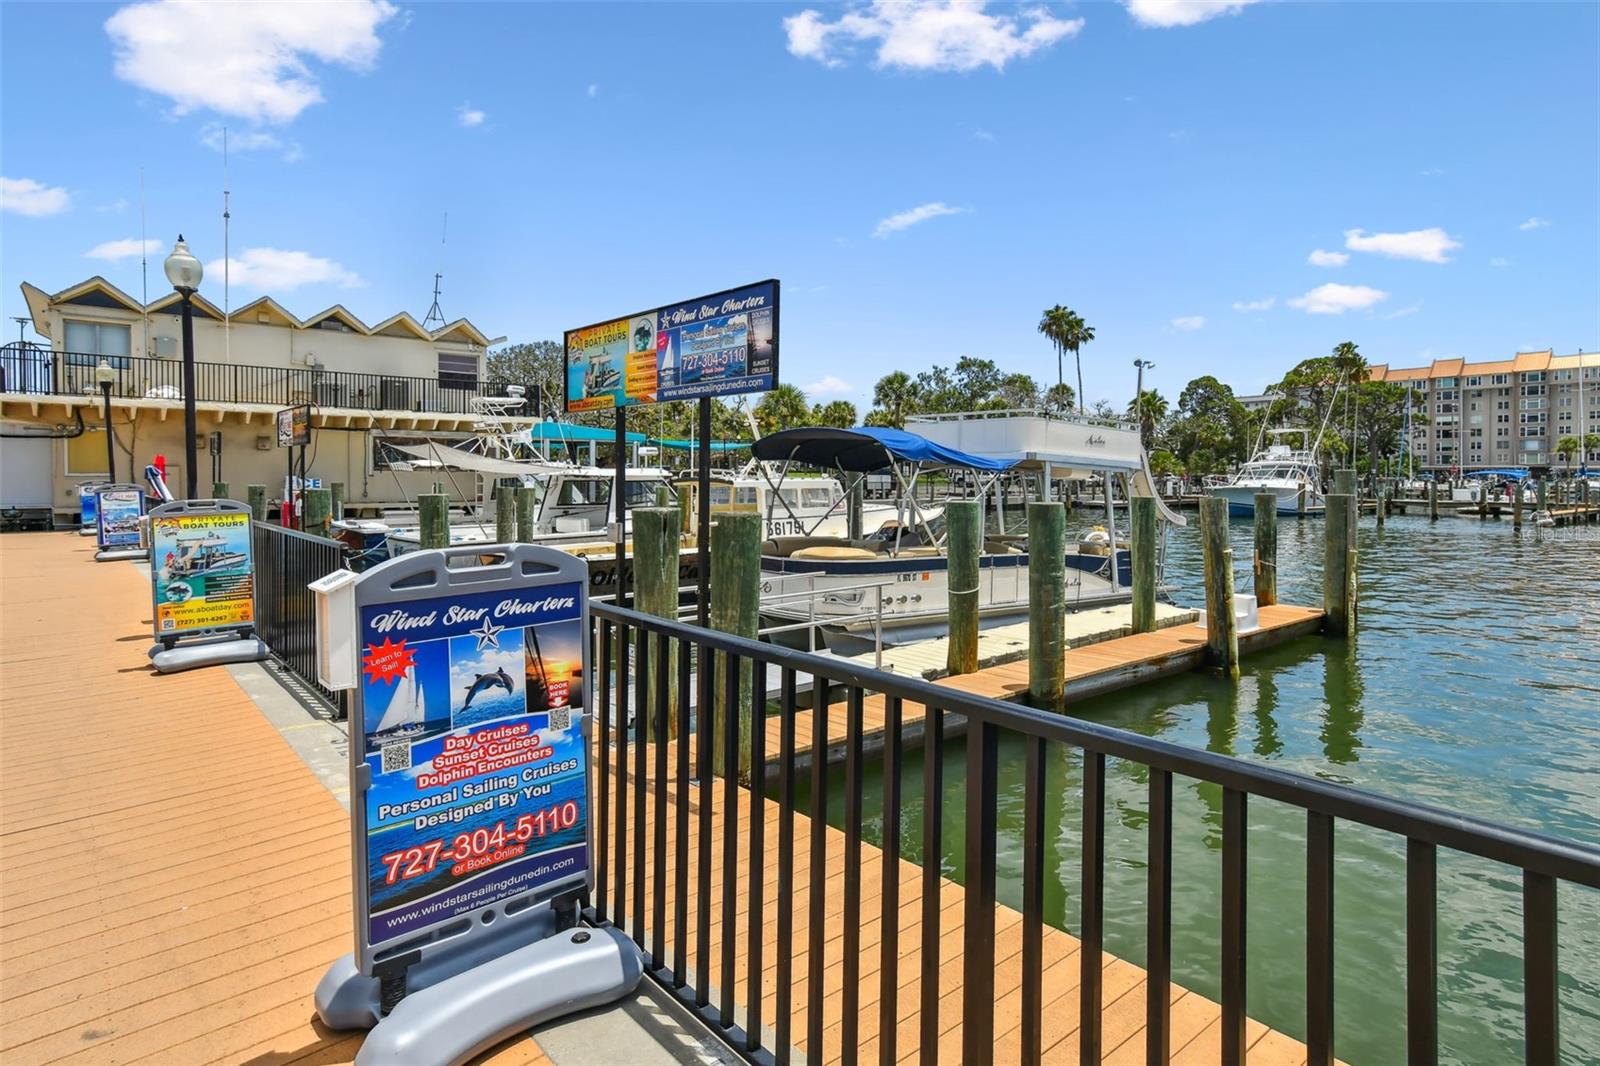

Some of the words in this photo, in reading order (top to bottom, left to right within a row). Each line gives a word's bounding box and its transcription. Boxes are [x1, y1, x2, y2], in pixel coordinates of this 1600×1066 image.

[672, 308, 697, 324] Wind
[698, 304, 719, 320] Star
[721, 296, 765, 313] Charters
[585, 336, 602, 348] BOAT
[604, 330, 627, 344] TOURS
[588, 325, 620, 338] PRIVATE
[682, 347, 746, 370] 727-304-5110
[663, 379, 764, 397] www.windstarsailingdunedin.com
[183, 522, 209, 530] BOAT
[213, 520, 244, 528] TOURS
[190, 514, 235, 523] PRIVATE
[174, 602, 250, 616] www.aboatday.com
[370, 609, 437, 633] Wind
[442, 605, 488, 625] Star
[494, 596, 575, 617] Charters
[176, 618, 196, 626] (727)
[370, 654, 393, 667] Learn
[549, 682, 568, 691] BOOK
[549, 689, 568, 698] HERE
[446, 738, 474, 751] Day
[477, 724, 528, 744] Cruises
[435, 747, 485, 768] Sunset
[488, 736, 538, 756] Cruises
[418, 765, 474, 788] Dolphin
[477, 748, 552, 774] Encounters
[379, 787, 457, 820] Personal
[463, 775, 518, 797] Sailing
[522, 758, 578, 782] Cruises
[415, 799, 494, 831] Designed
[498, 790, 519, 808] By
[522, 784, 551, 800] You
[384, 802, 577, 884] 727-304-5110
[454, 863, 464, 873] or
[466, 855, 492, 871] Book
[494, 845, 524, 861] Online
[386, 855, 575, 928] www.windstarsailingdunedin.com
[454, 904, 470, 915] (Max
[476, 896, 496, 908] People
[496, 892, 507, 900] Per
[507, 884, 529, 896] Cruise)
